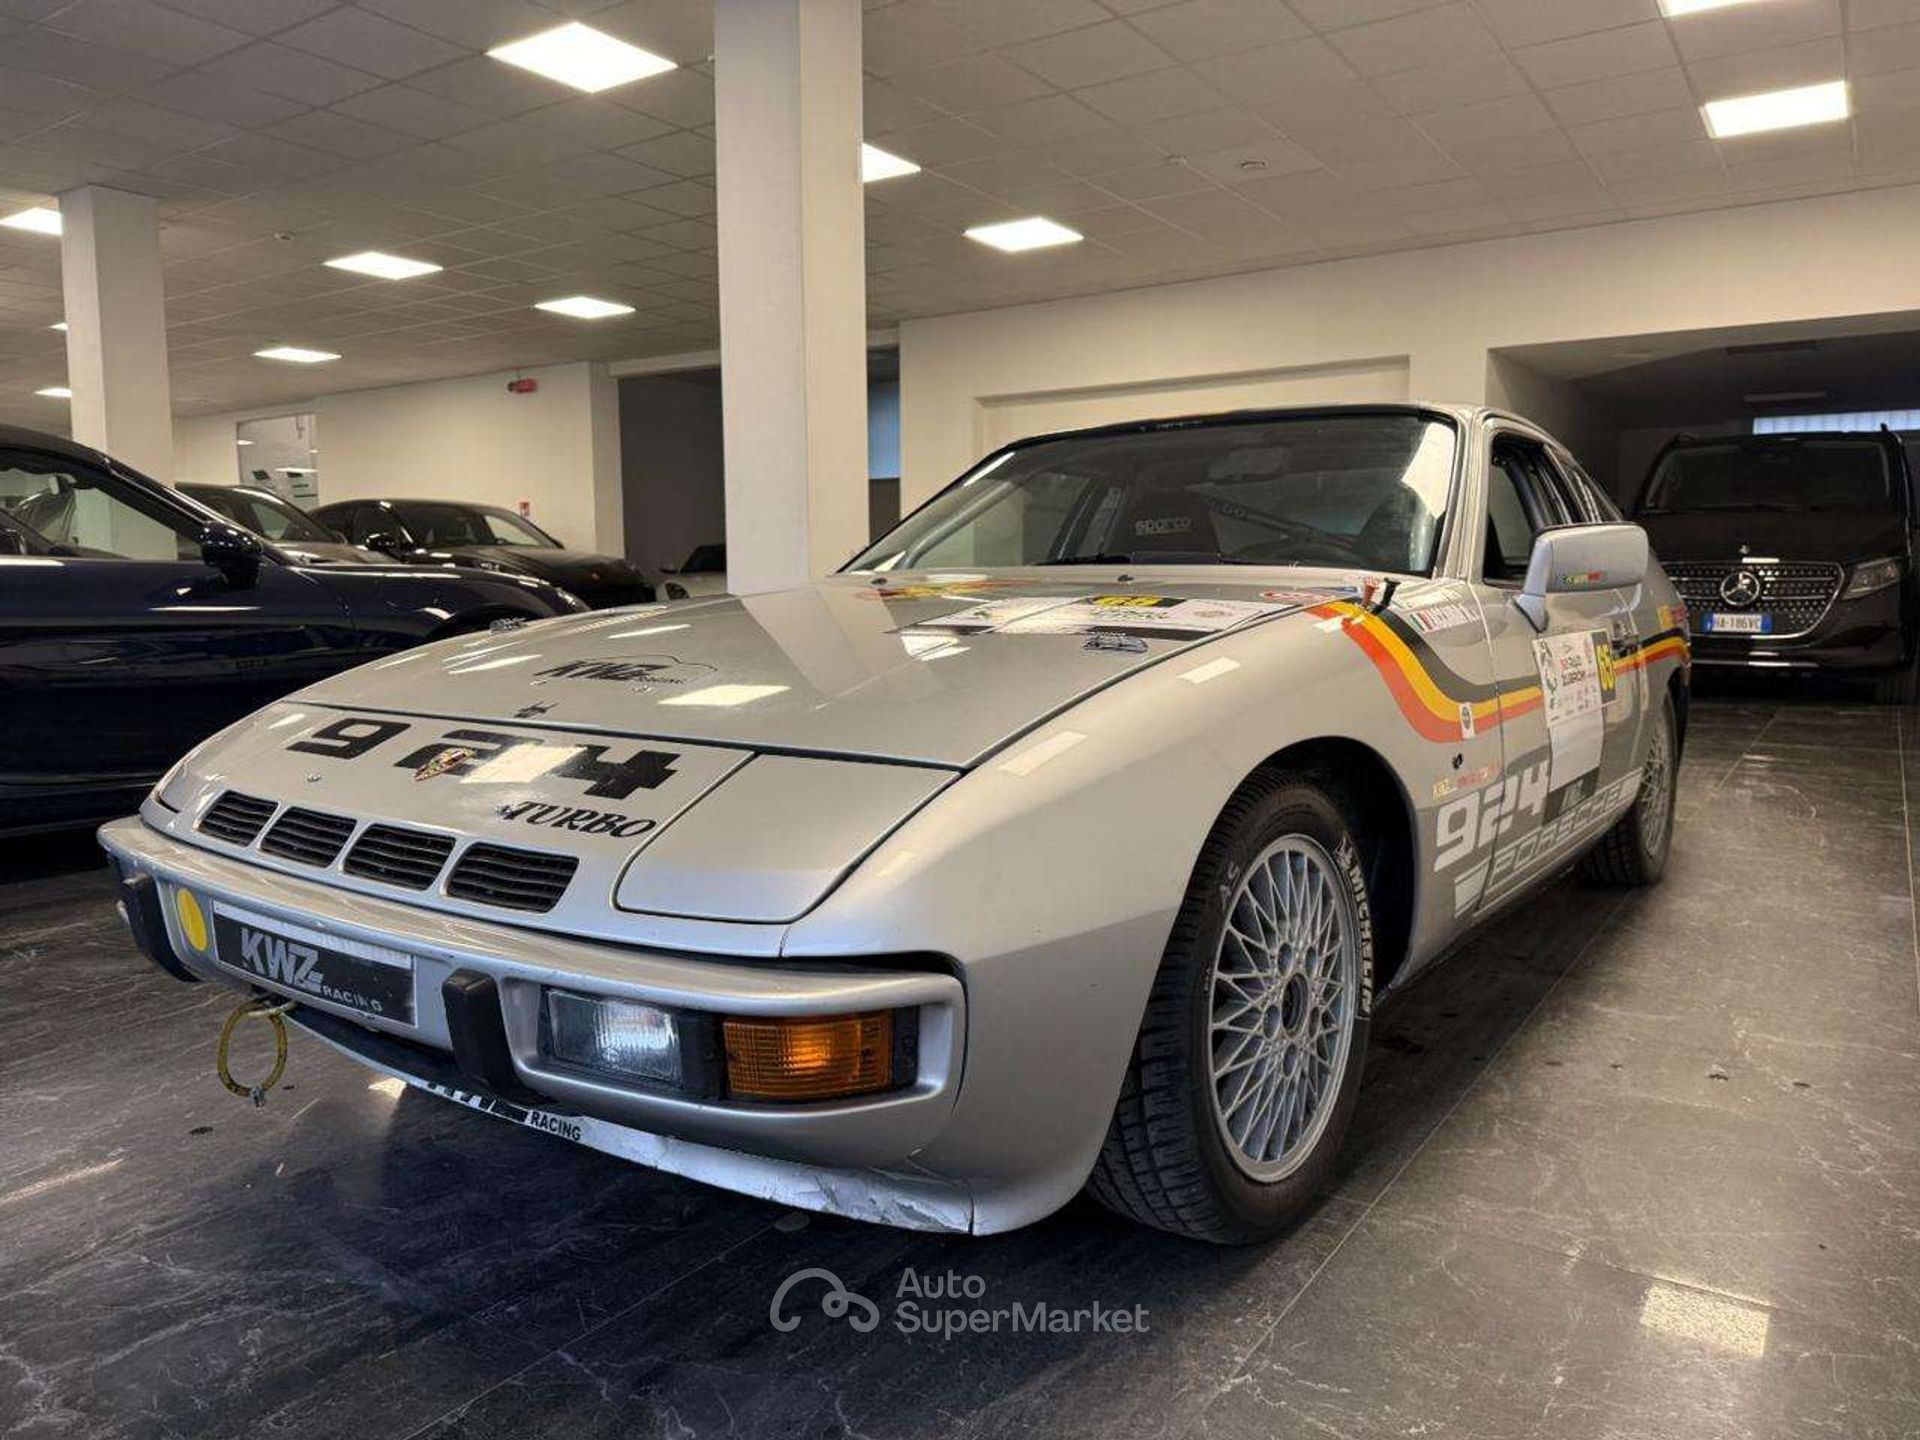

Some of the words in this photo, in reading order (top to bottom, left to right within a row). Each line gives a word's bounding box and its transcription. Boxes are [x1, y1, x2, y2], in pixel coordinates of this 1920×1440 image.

[287, 718, 681, 800] 924
[508, 800, 657, 838] TURBO
[1434, 760, 1550, 872] 924
[241, 927, 324, 994] KWZ
[322, 985, 383, 1012] RACING
[531, 1111, 582, 1142] RACING
